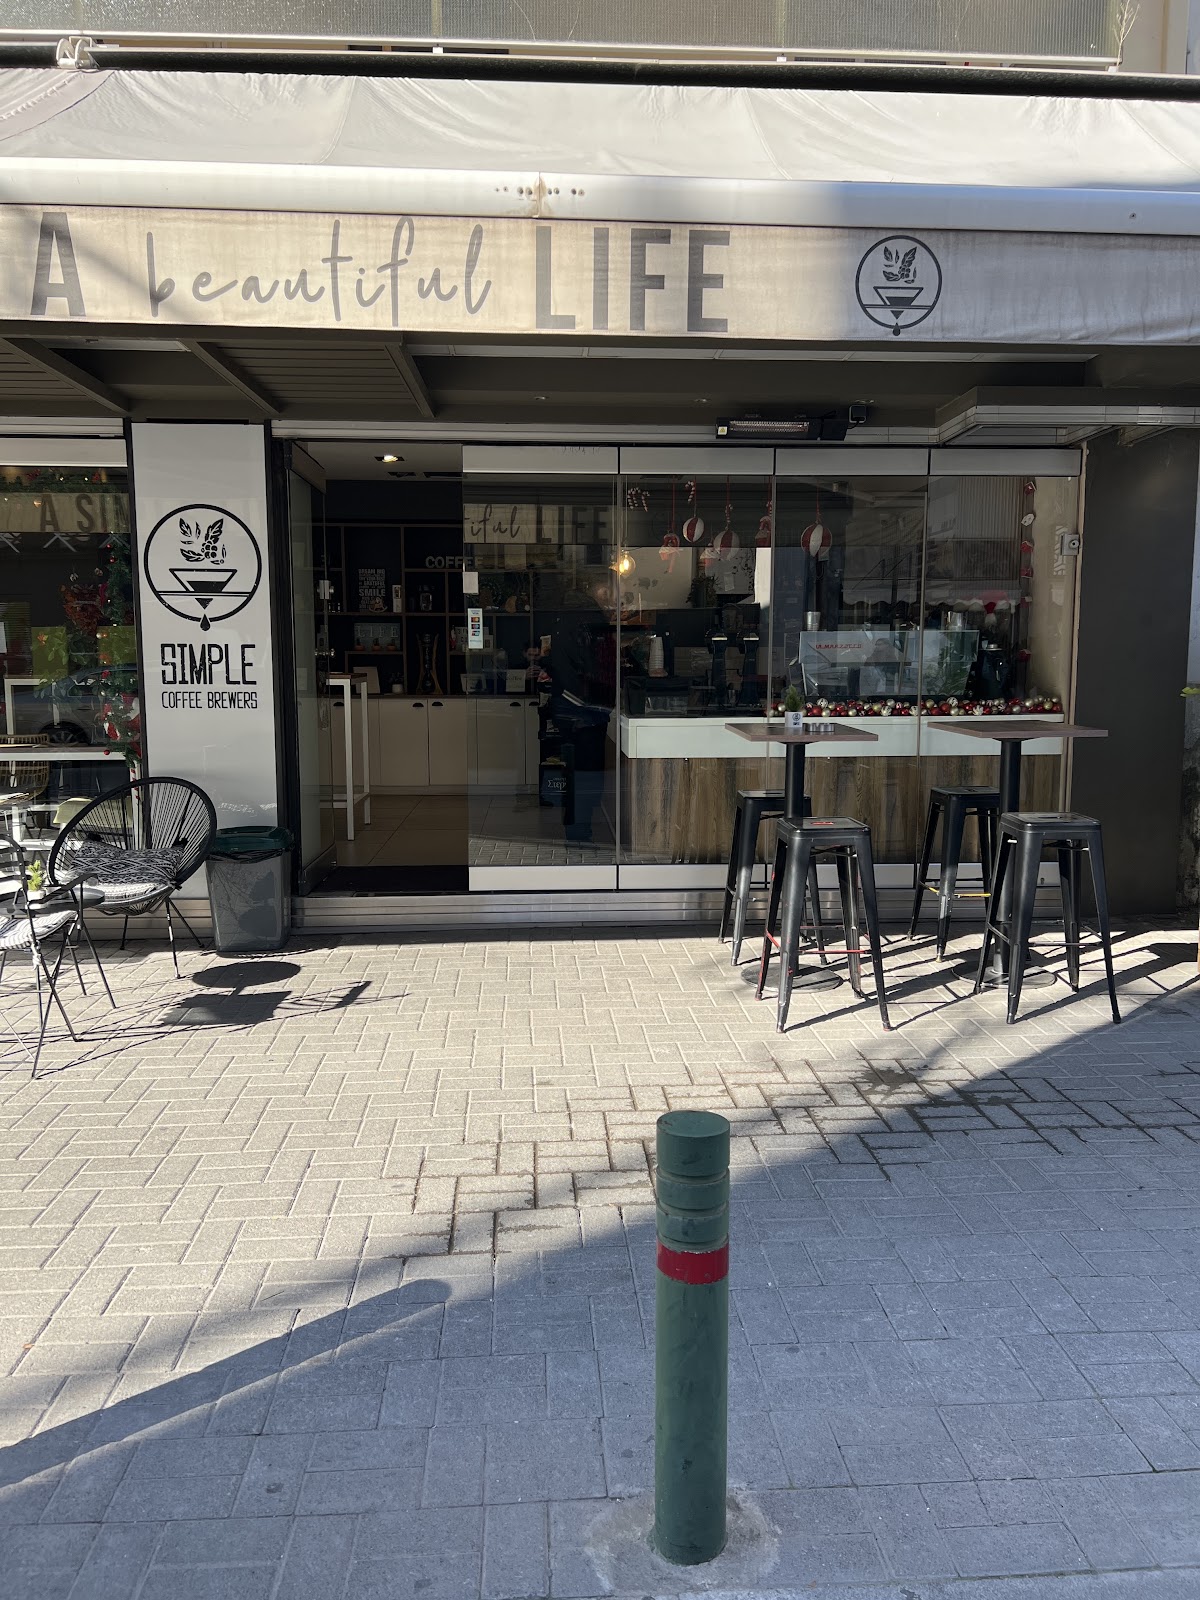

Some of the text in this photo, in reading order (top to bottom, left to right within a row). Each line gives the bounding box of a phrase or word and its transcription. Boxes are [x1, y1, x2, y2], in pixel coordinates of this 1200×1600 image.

[30, 212, 731, 333] A beautiful LIFE
[40, 494, 60, 532] A
[536, 506, 609, 544] LIFE
[358, 588, 386, 597] SMILE
[160, 643, 257, 685] SIMPLE
[161, 691, 258, 709] COFFEE BREWERS
